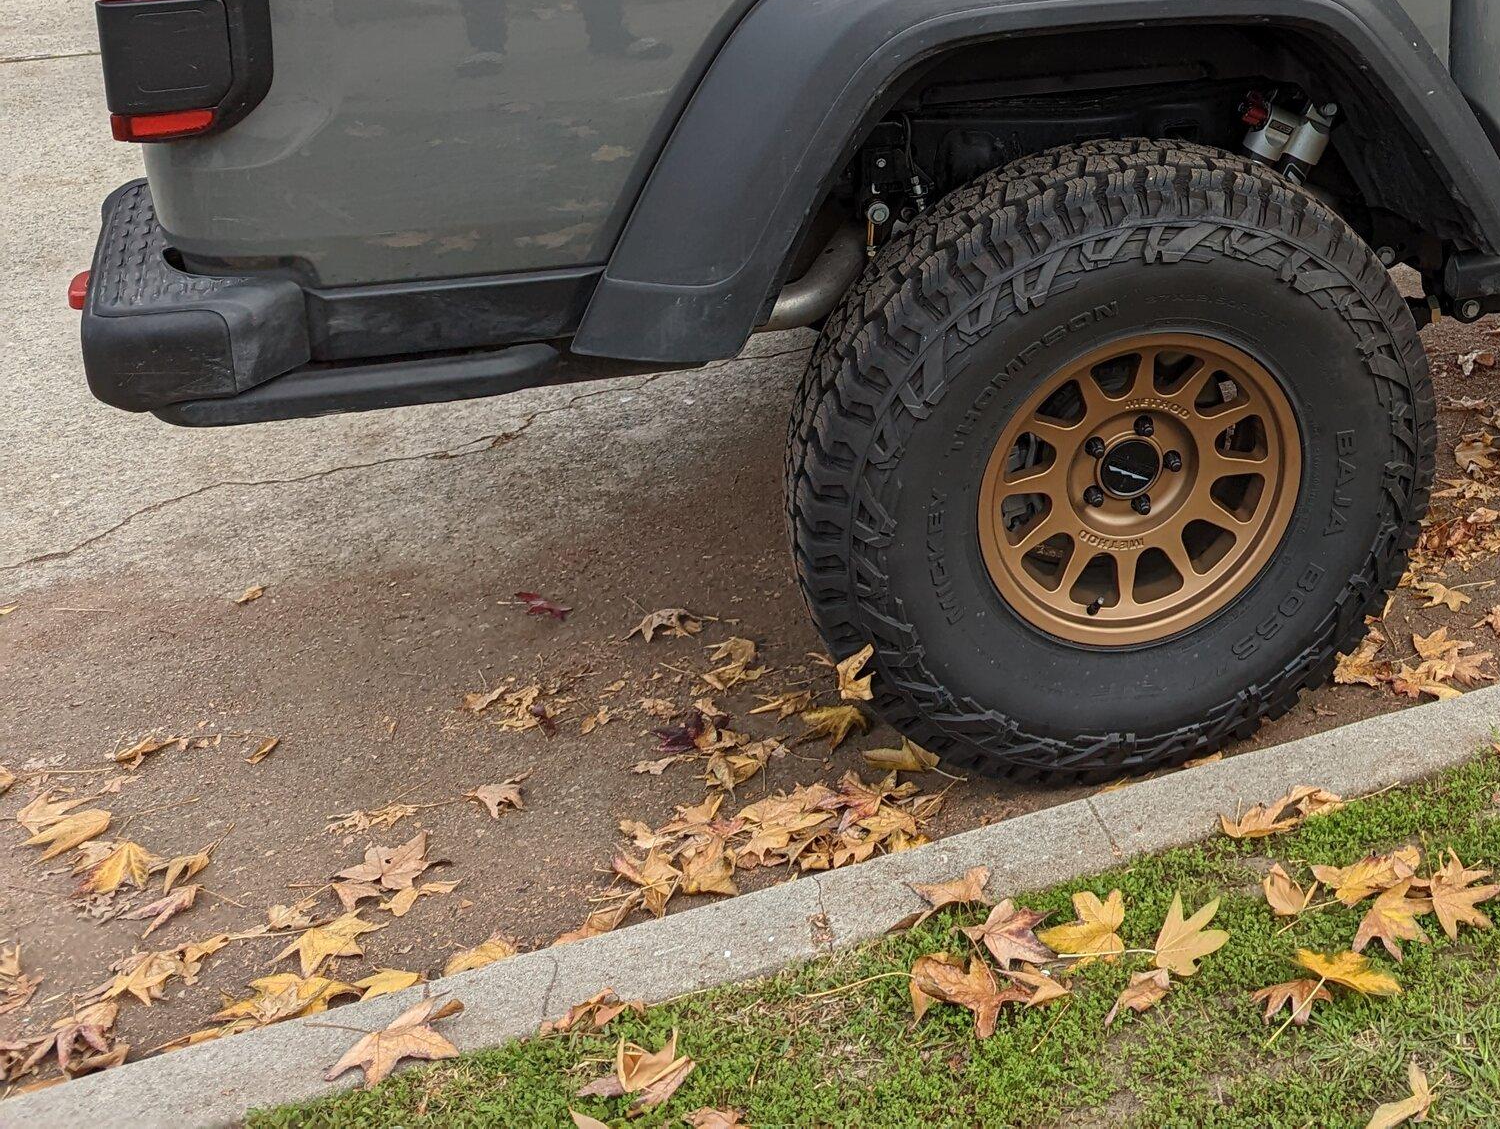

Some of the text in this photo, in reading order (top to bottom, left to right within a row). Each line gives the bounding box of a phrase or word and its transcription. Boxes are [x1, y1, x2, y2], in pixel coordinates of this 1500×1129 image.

[1125, 398, 1190, 419] METHOD
[926, 487, 966, 626] MICKEY
[1079, 529, 1145, 551] METHOD
[1231, 429, 1359, 660] BAJA BOSS
